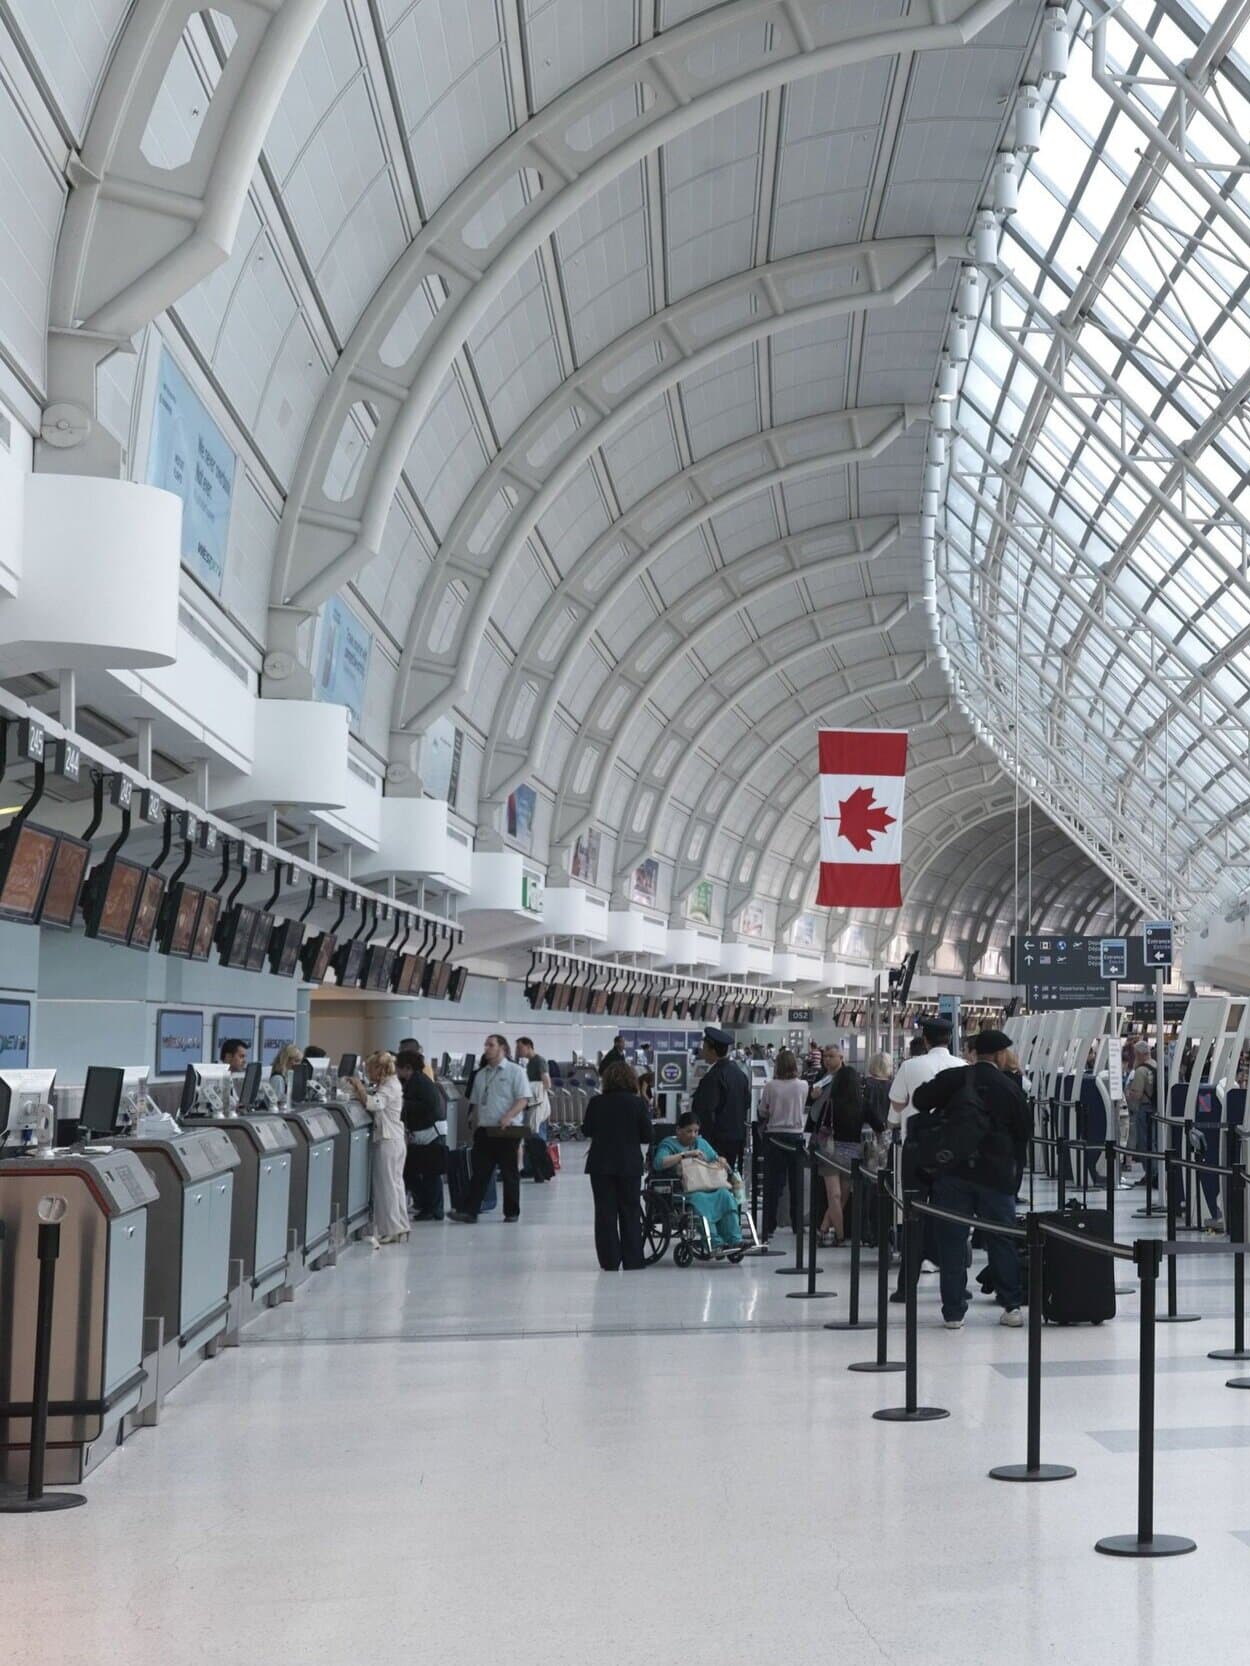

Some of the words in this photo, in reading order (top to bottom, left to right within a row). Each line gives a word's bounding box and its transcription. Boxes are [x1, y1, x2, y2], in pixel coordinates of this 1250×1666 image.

[30, 726, 44, 755] 245
[65, 746, 79, 775] 244
[121, 779, 132, 806] 243
